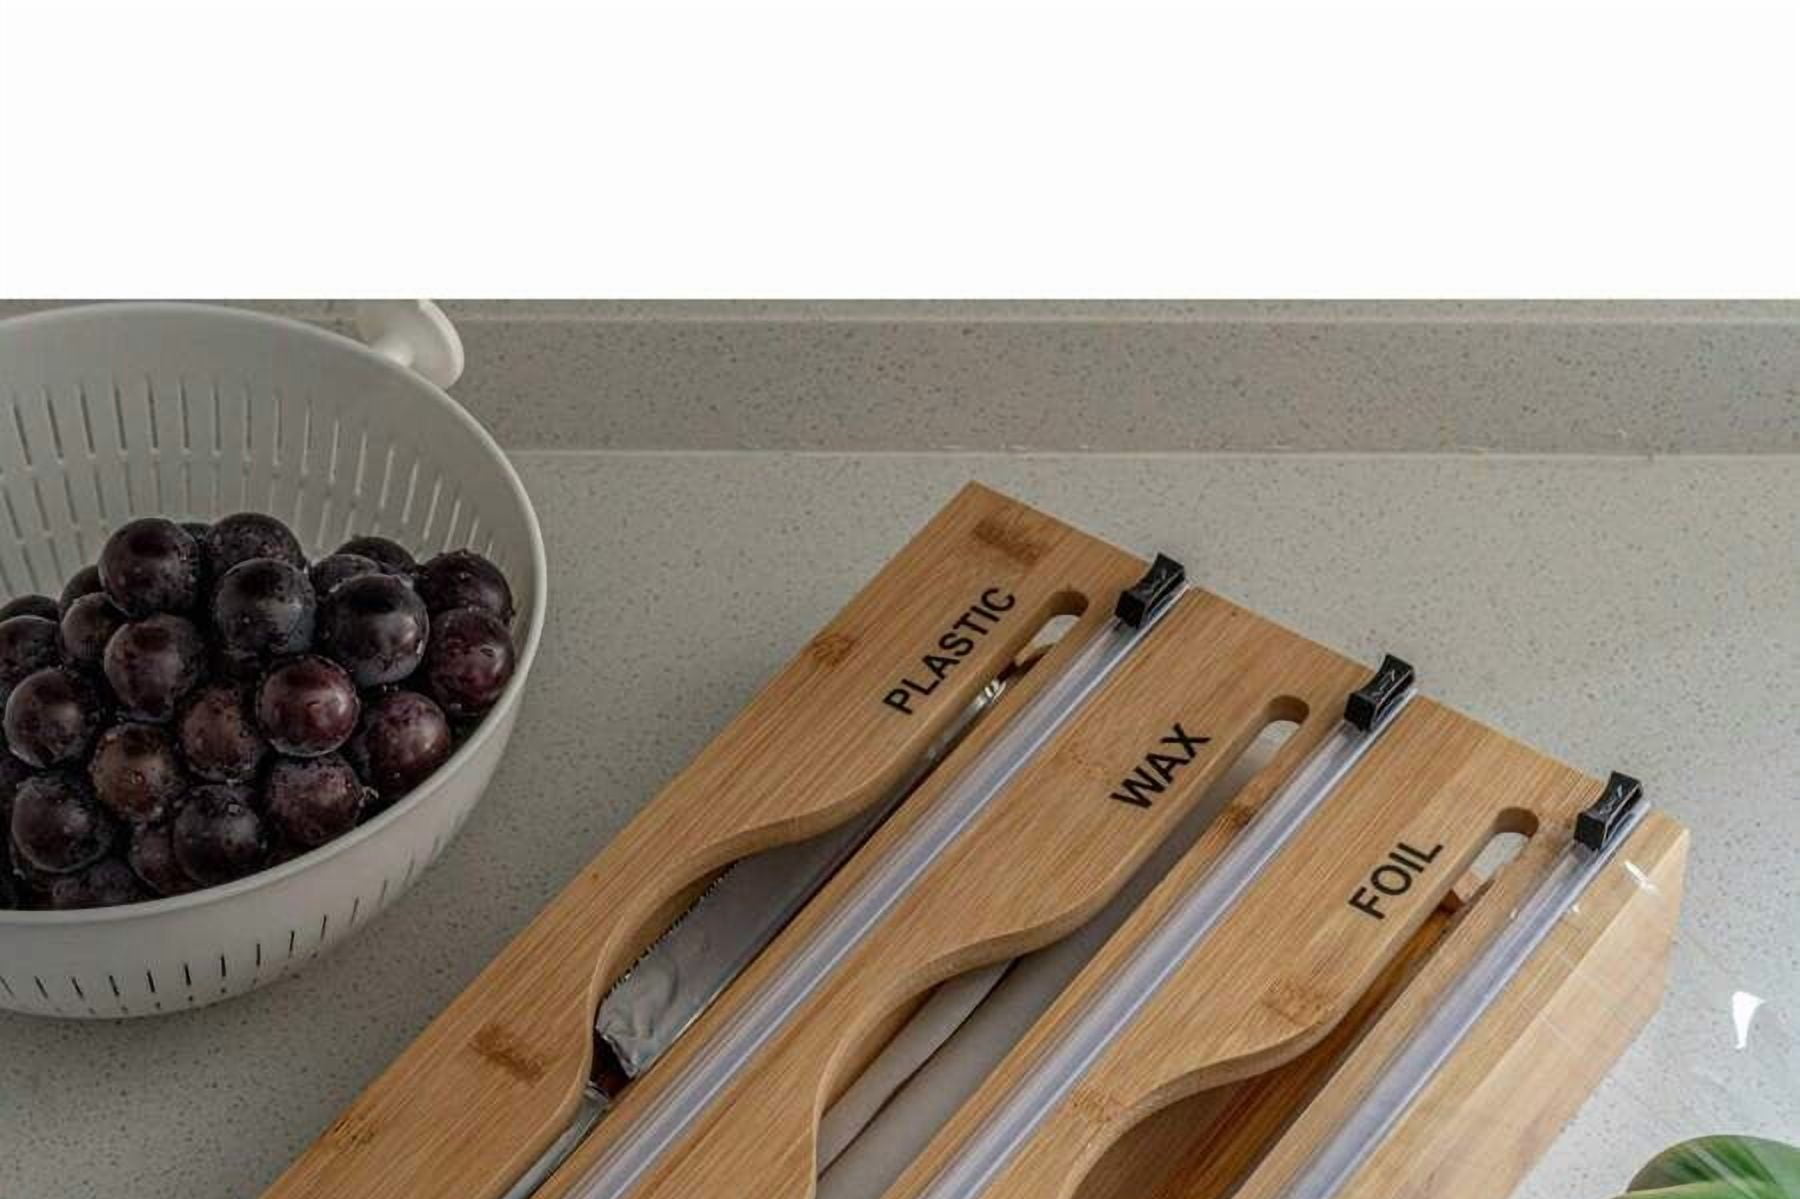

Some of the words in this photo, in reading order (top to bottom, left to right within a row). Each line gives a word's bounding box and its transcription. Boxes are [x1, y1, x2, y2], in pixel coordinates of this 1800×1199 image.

[882, 586, 1017, 717] PLASTIC
[1109, 722, 1212, 811] WAX
[1347, 841, 1443, 920] FOIL
